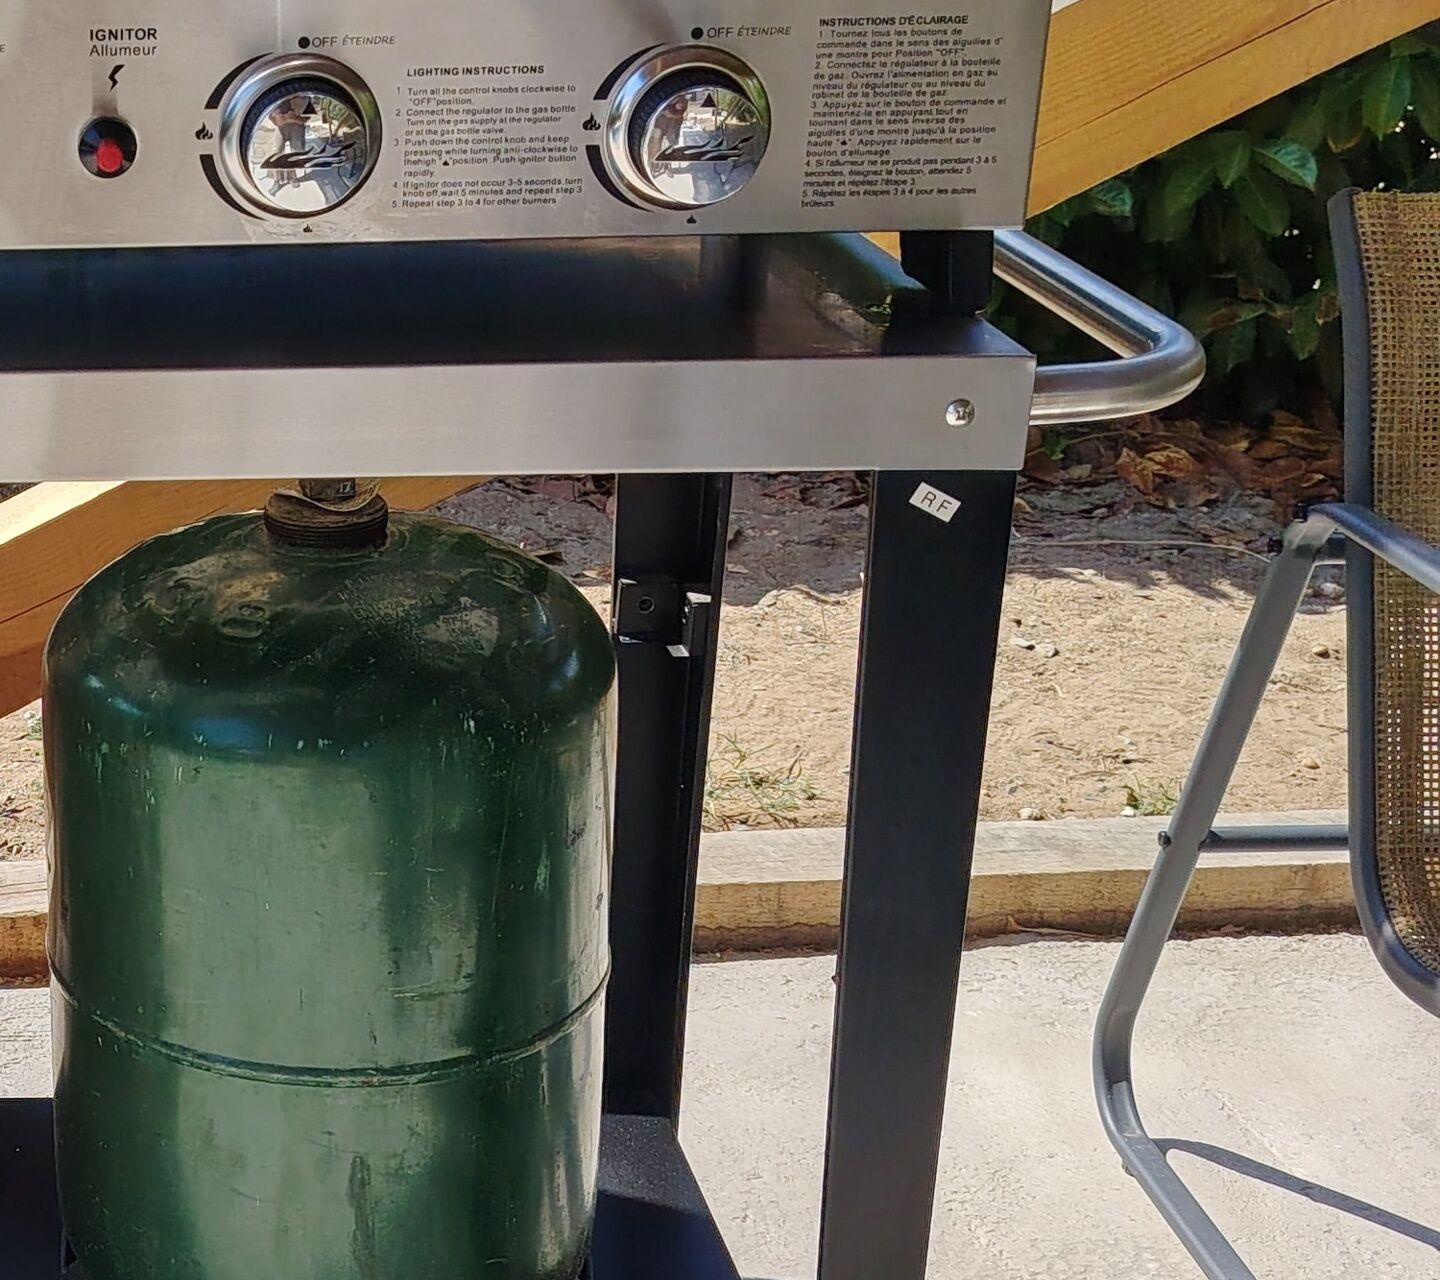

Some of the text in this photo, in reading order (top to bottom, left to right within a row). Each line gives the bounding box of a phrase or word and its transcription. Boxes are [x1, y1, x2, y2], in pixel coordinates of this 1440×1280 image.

[819, 17, 896, 27] INSTRUCTIONS
[90, 28, 157, 41] IGNITOR
[707, 25, 791, 38] OFF ÉTEINDRE
[312, 34, 395, 47] OFF ÉTEINDRE
[90, 44, 157, 56] Allumeur
[407, 65, 545, 77] LIGHTING INSTRUCTIONS
